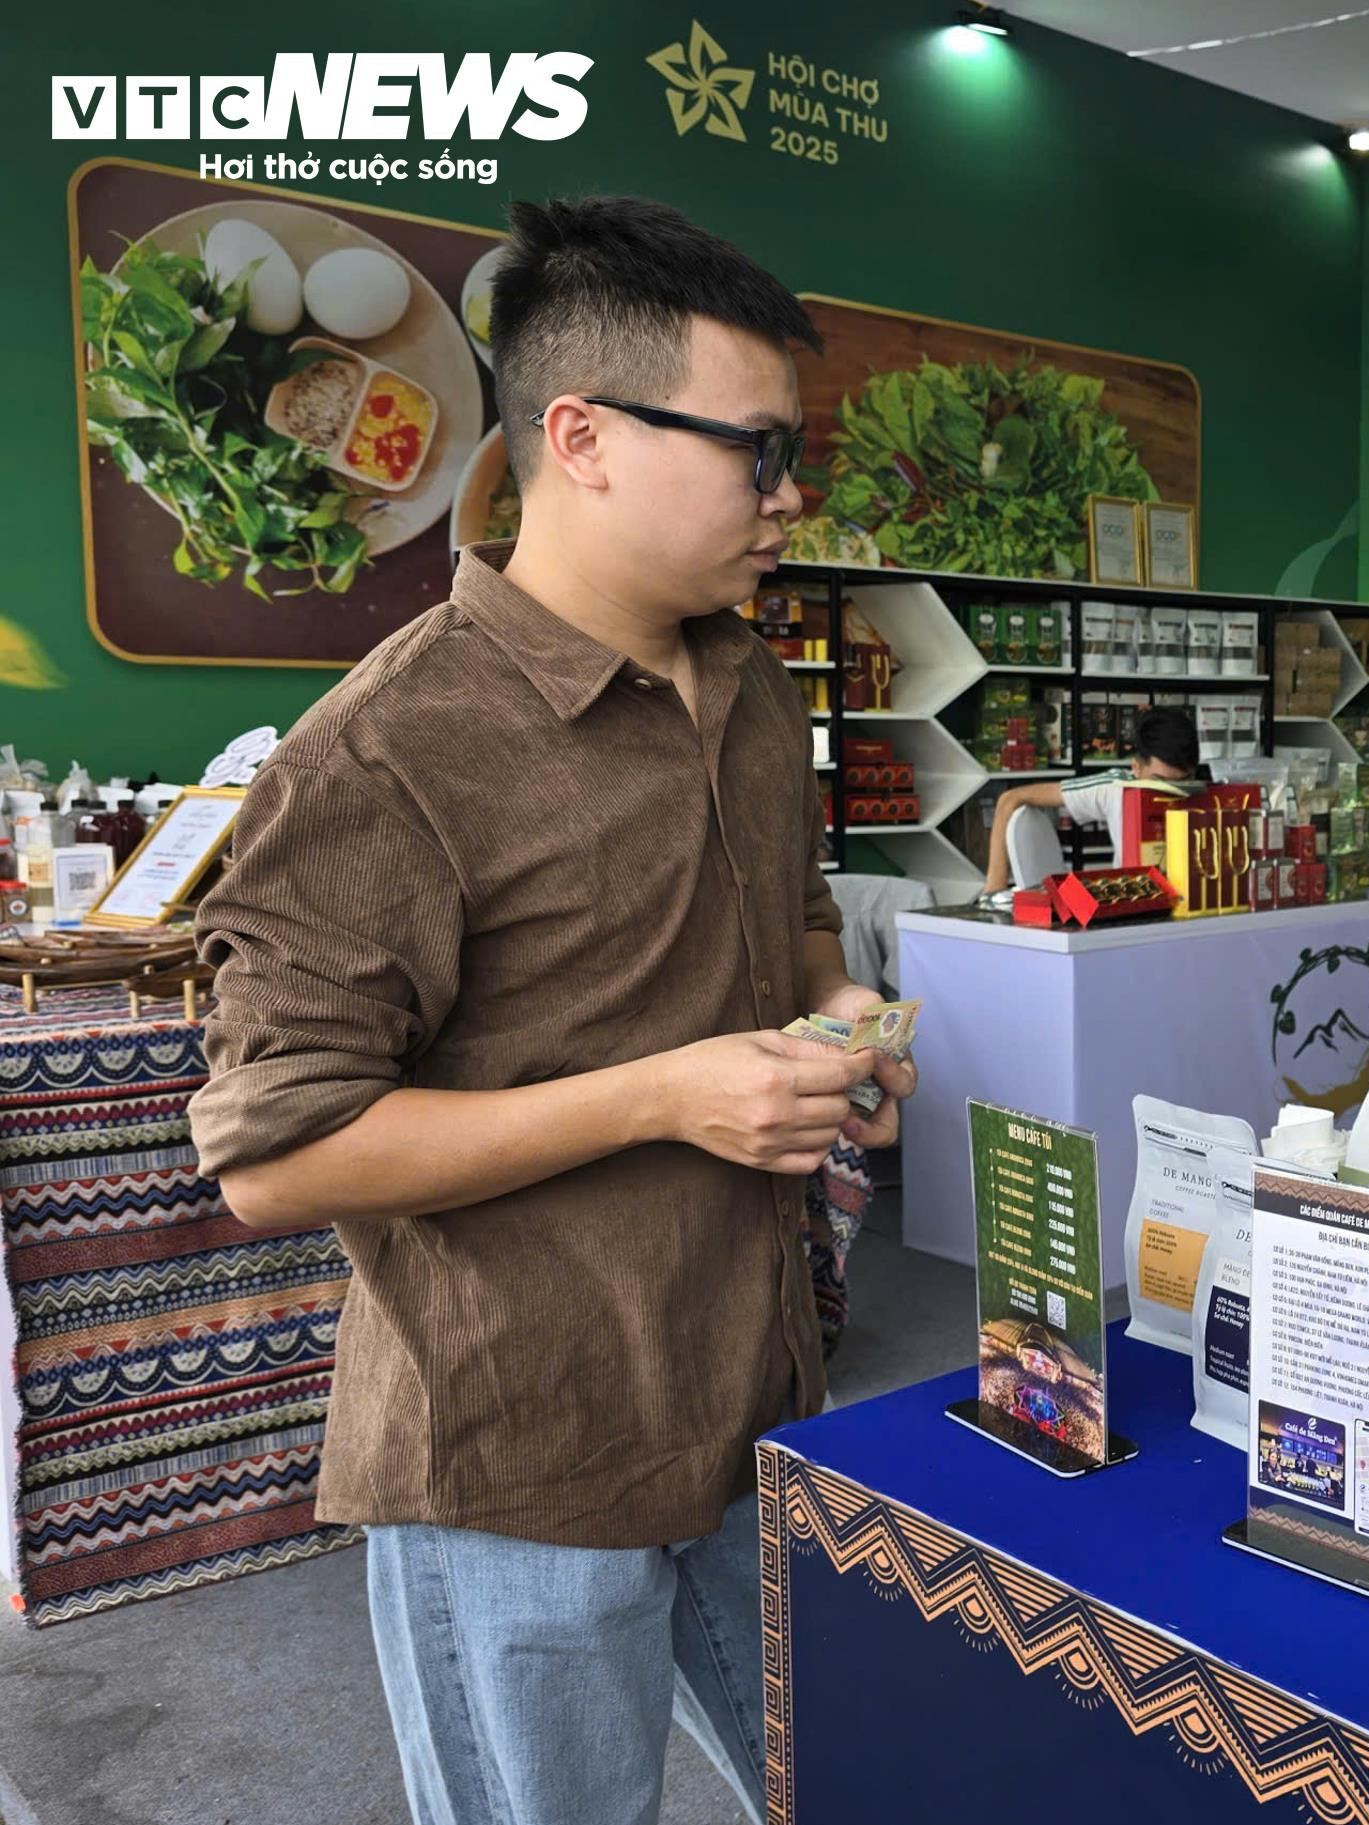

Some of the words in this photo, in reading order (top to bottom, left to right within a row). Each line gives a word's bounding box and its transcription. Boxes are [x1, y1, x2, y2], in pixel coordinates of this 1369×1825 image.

[768, 52, 815, 88] HỘI
[822, 70, 880, 109] CHỢ
[770, 89, 829, 128] MÙA
[835, 107, 888, 142] THU
[771, 127, 838, 164] 2025
[1163, 1167, 1177, 1179] DE
[1181, 1174, 1213, 1187] MANG
